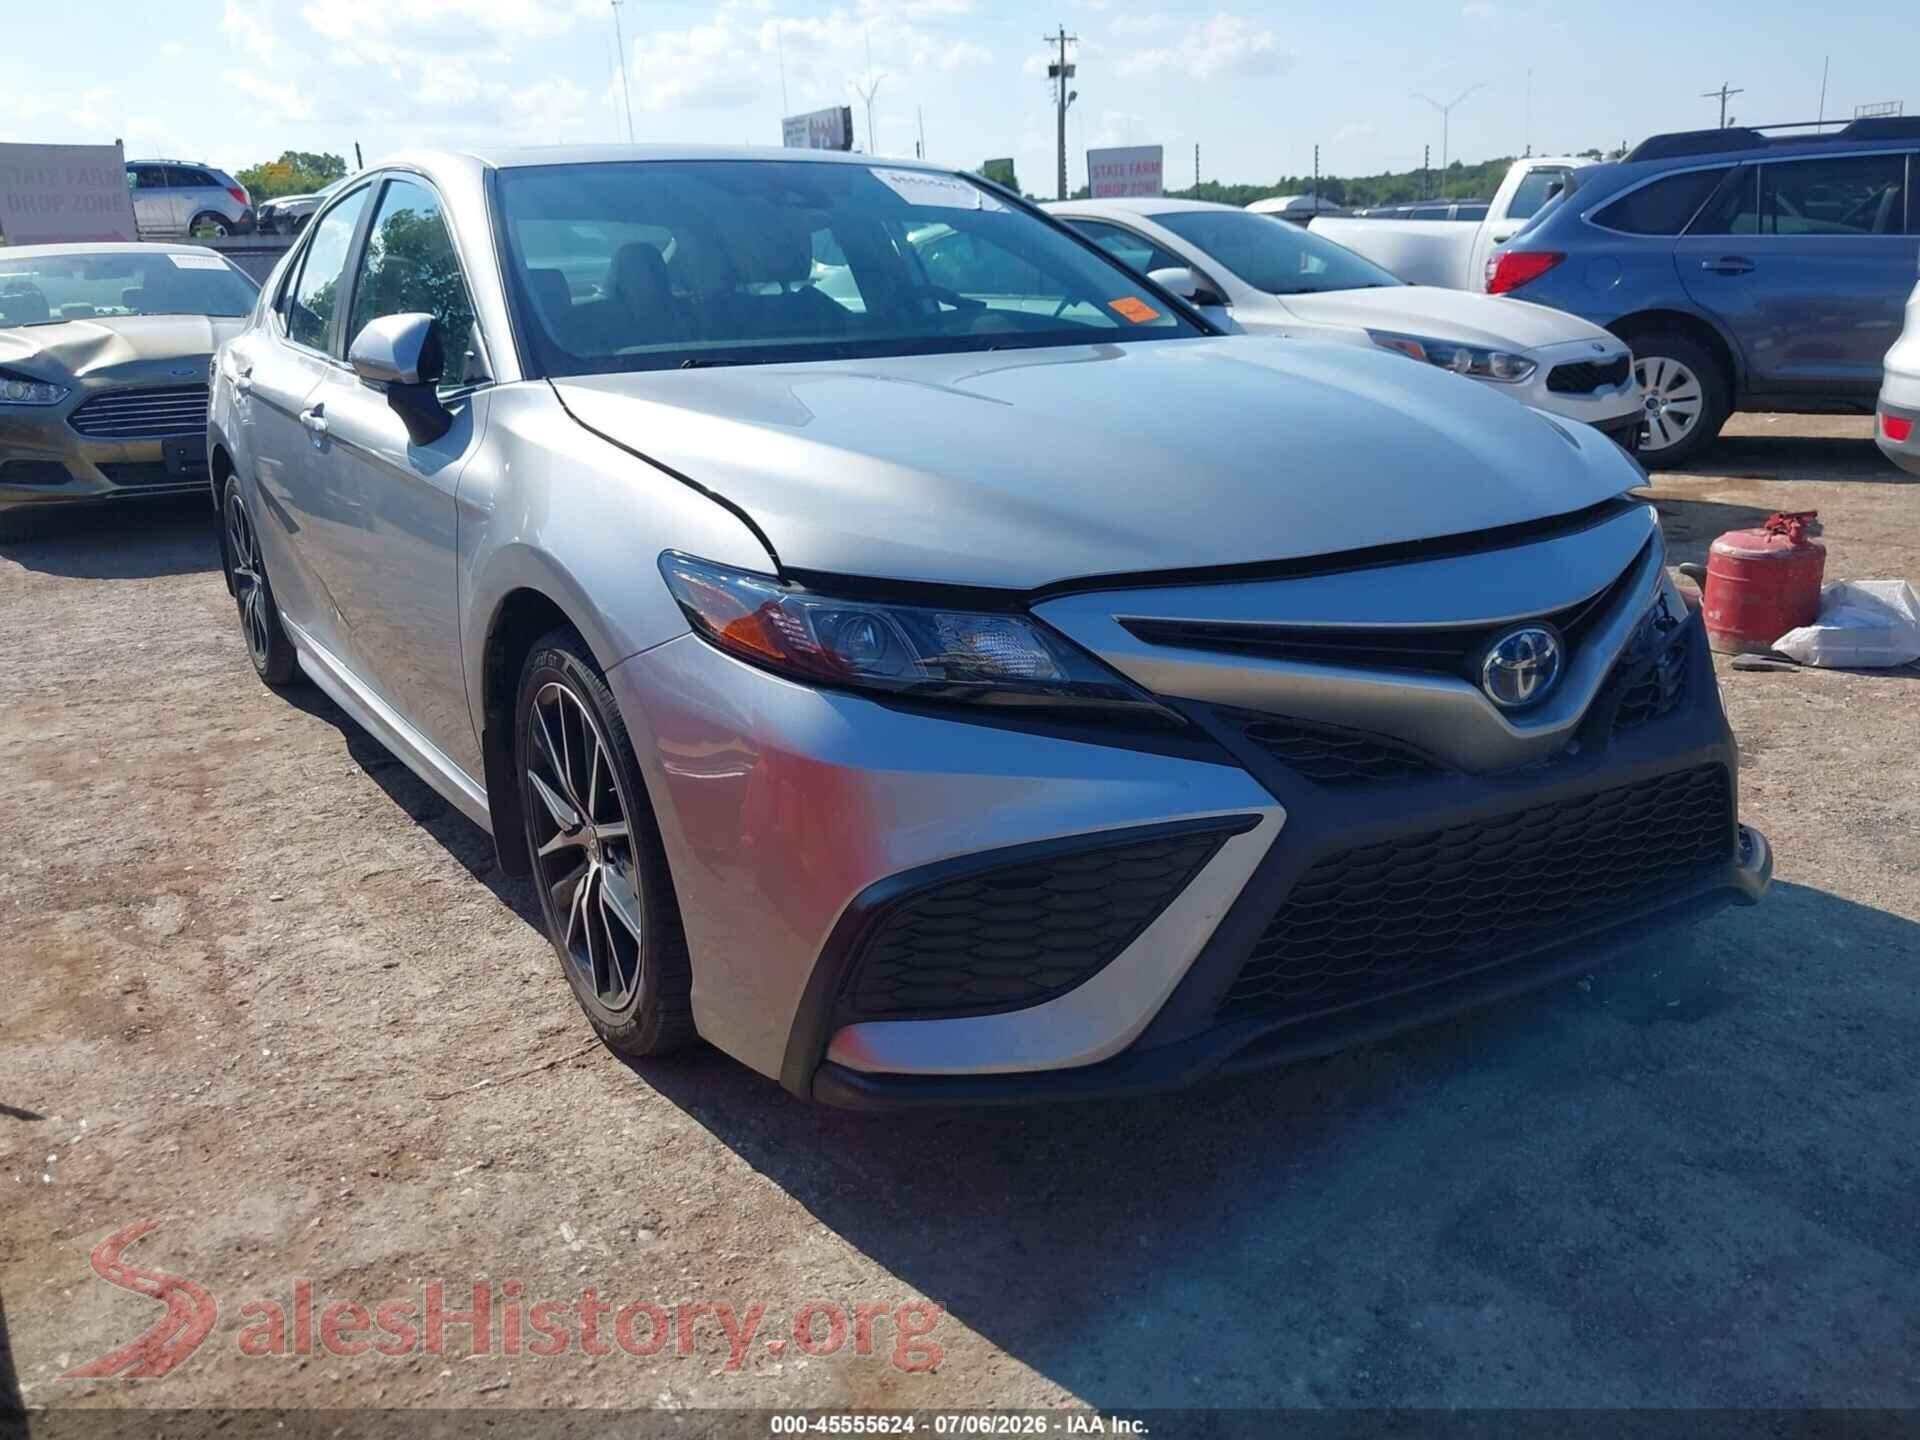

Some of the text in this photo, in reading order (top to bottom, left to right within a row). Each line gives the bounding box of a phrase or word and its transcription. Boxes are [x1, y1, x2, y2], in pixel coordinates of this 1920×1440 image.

[6, 166, 57, 186] TATE
[1093, 160, 1161, 178] STATE FARM
[7, 192, 125, 213] DROP ZONE
